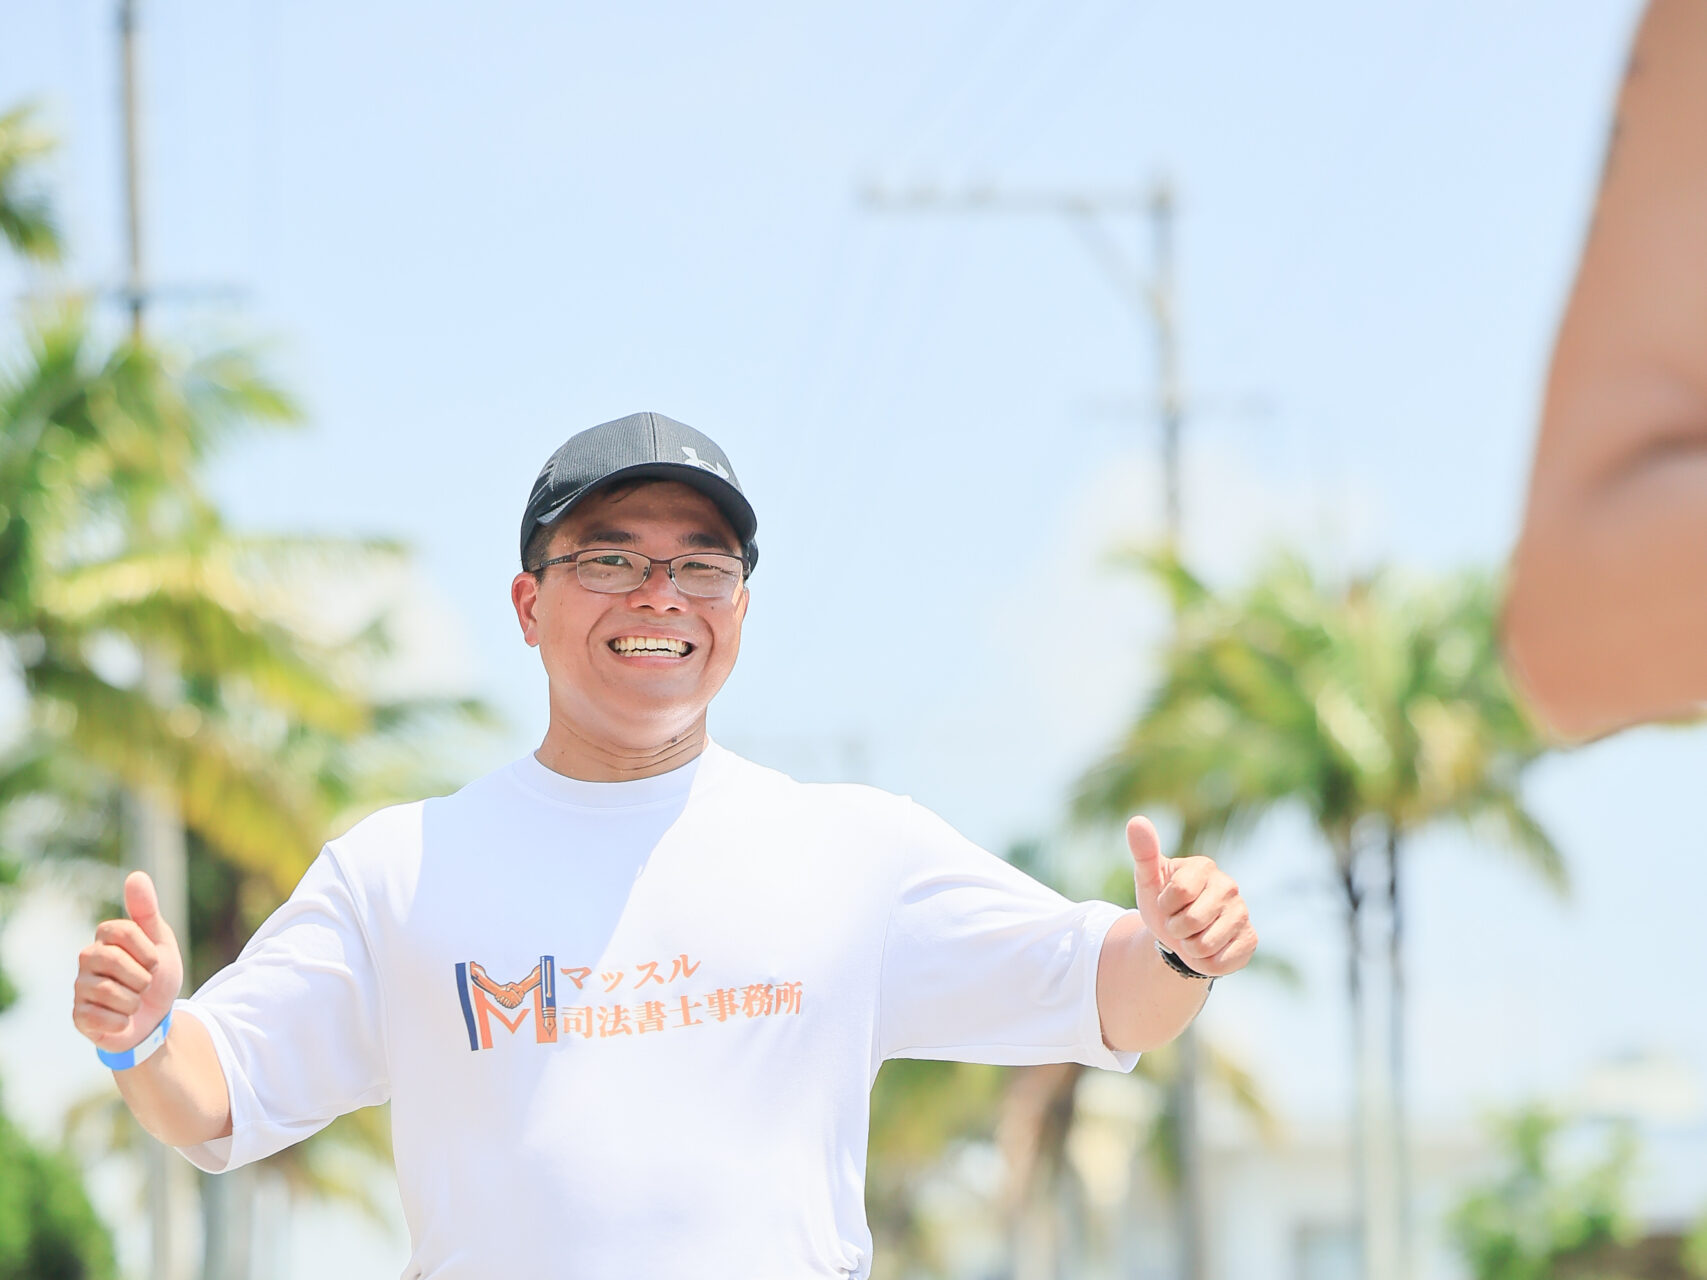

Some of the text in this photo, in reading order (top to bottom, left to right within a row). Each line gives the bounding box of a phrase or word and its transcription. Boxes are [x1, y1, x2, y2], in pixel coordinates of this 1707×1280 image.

[560, 953, 702, 993] マッスル
[561, 981, 804, 1040] 司法書士事務所
